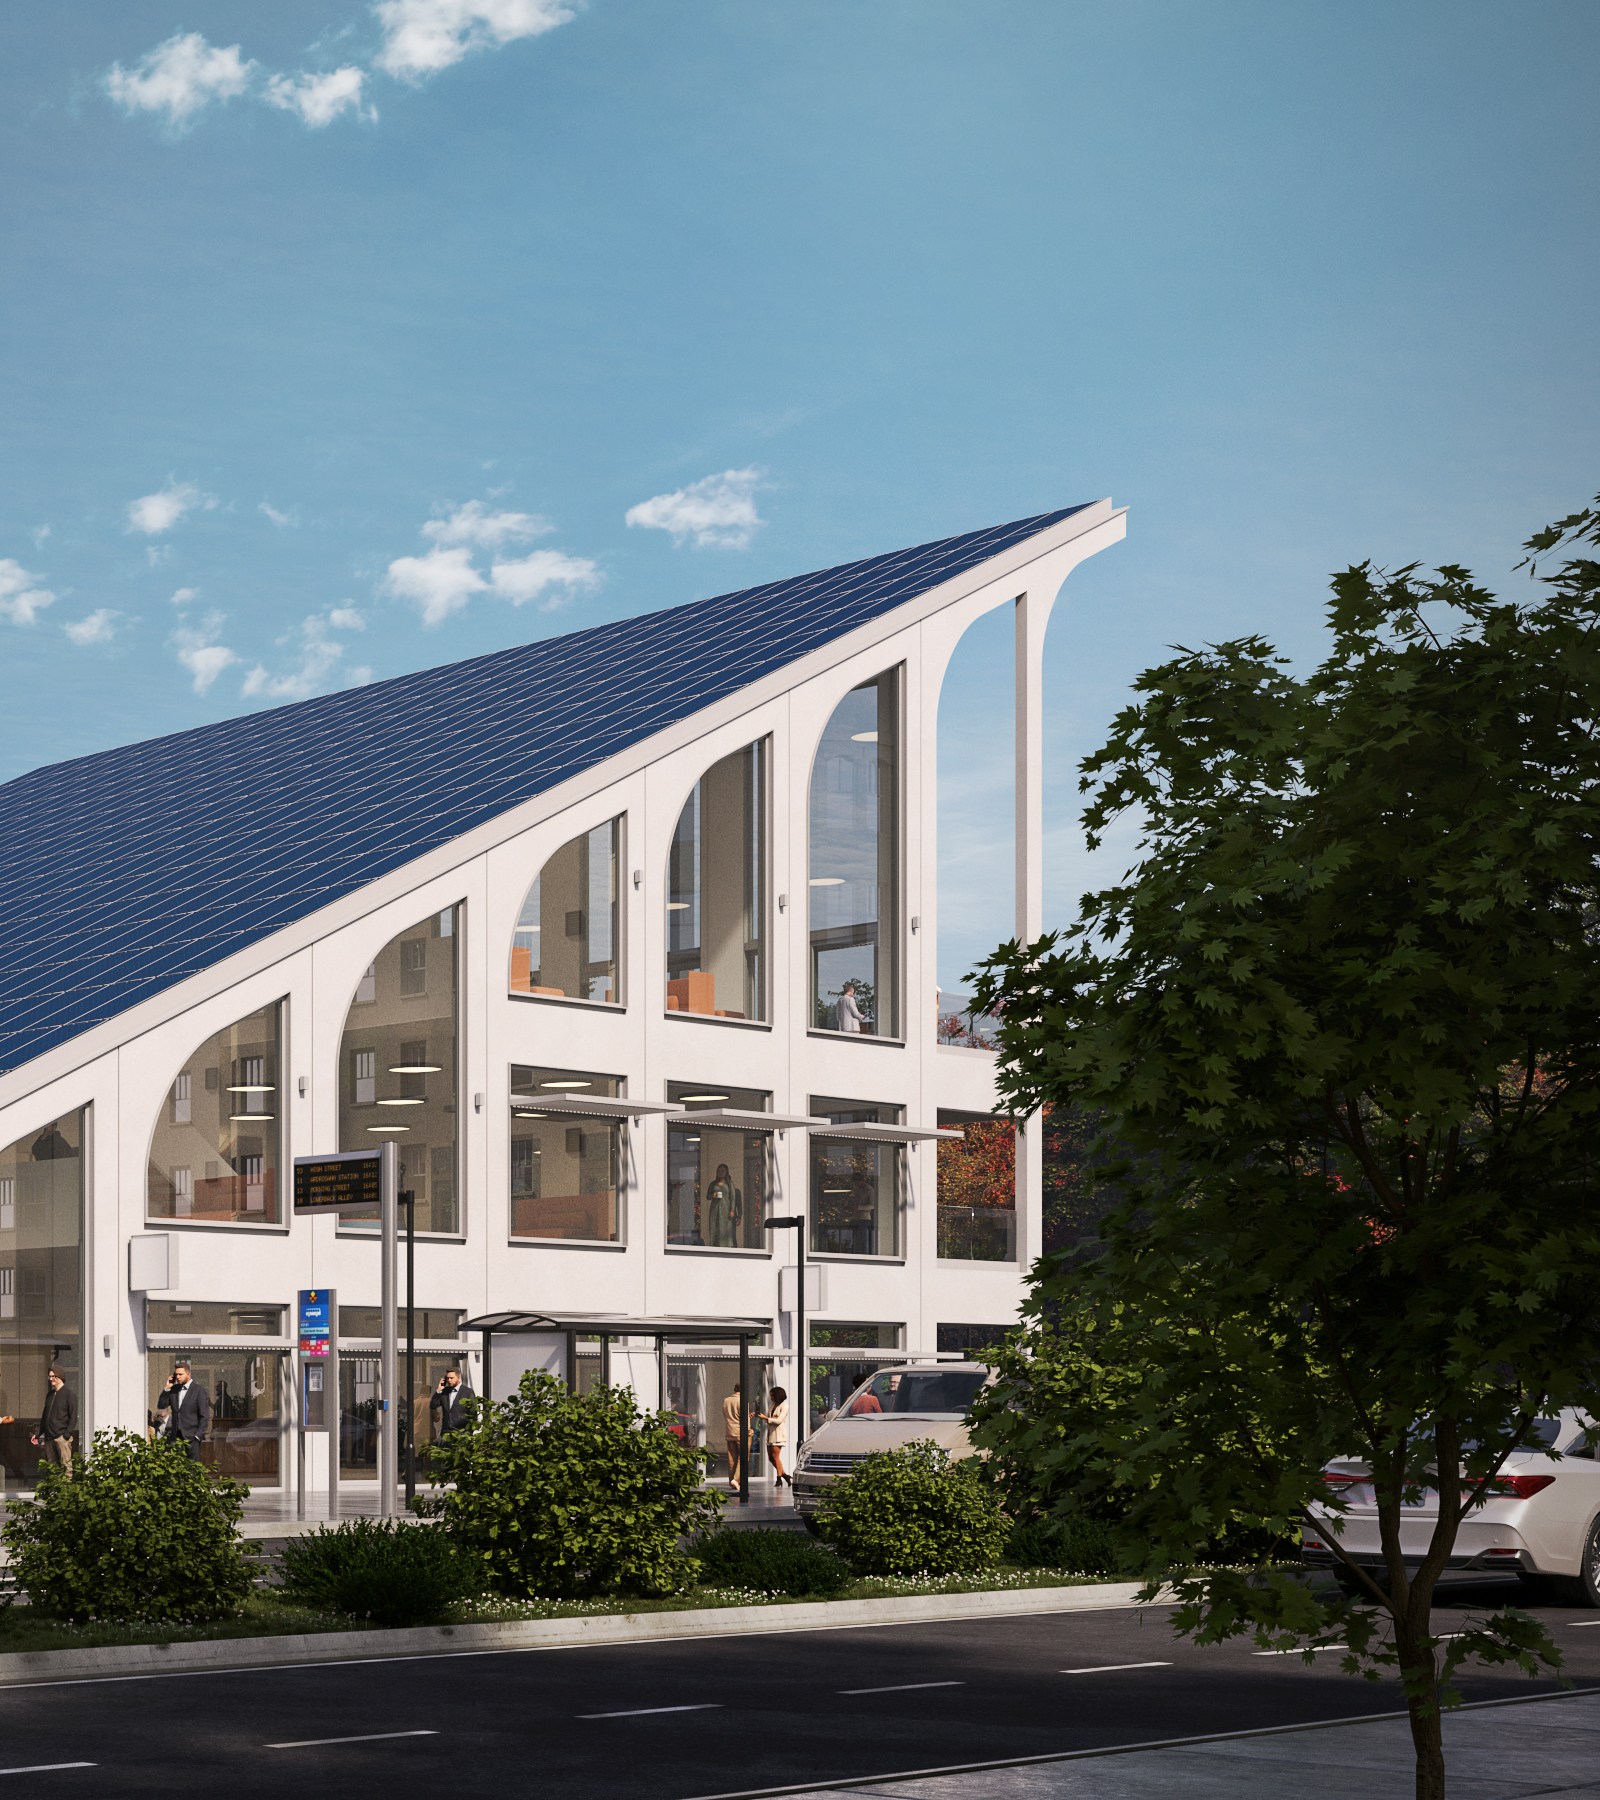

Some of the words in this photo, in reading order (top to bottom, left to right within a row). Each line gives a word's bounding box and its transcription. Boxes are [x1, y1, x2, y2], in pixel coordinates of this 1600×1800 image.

[310, 1166, 322, 1174] HIGH
[324, 1164, 342, 1172] STREET
[338, 1173, 359, 1181] STATION
[310, 1185, 331, 1193] MORNING
[332, 1183, 350, 1192] STREET
[338, 1193, 353, 1201] ALLEY
